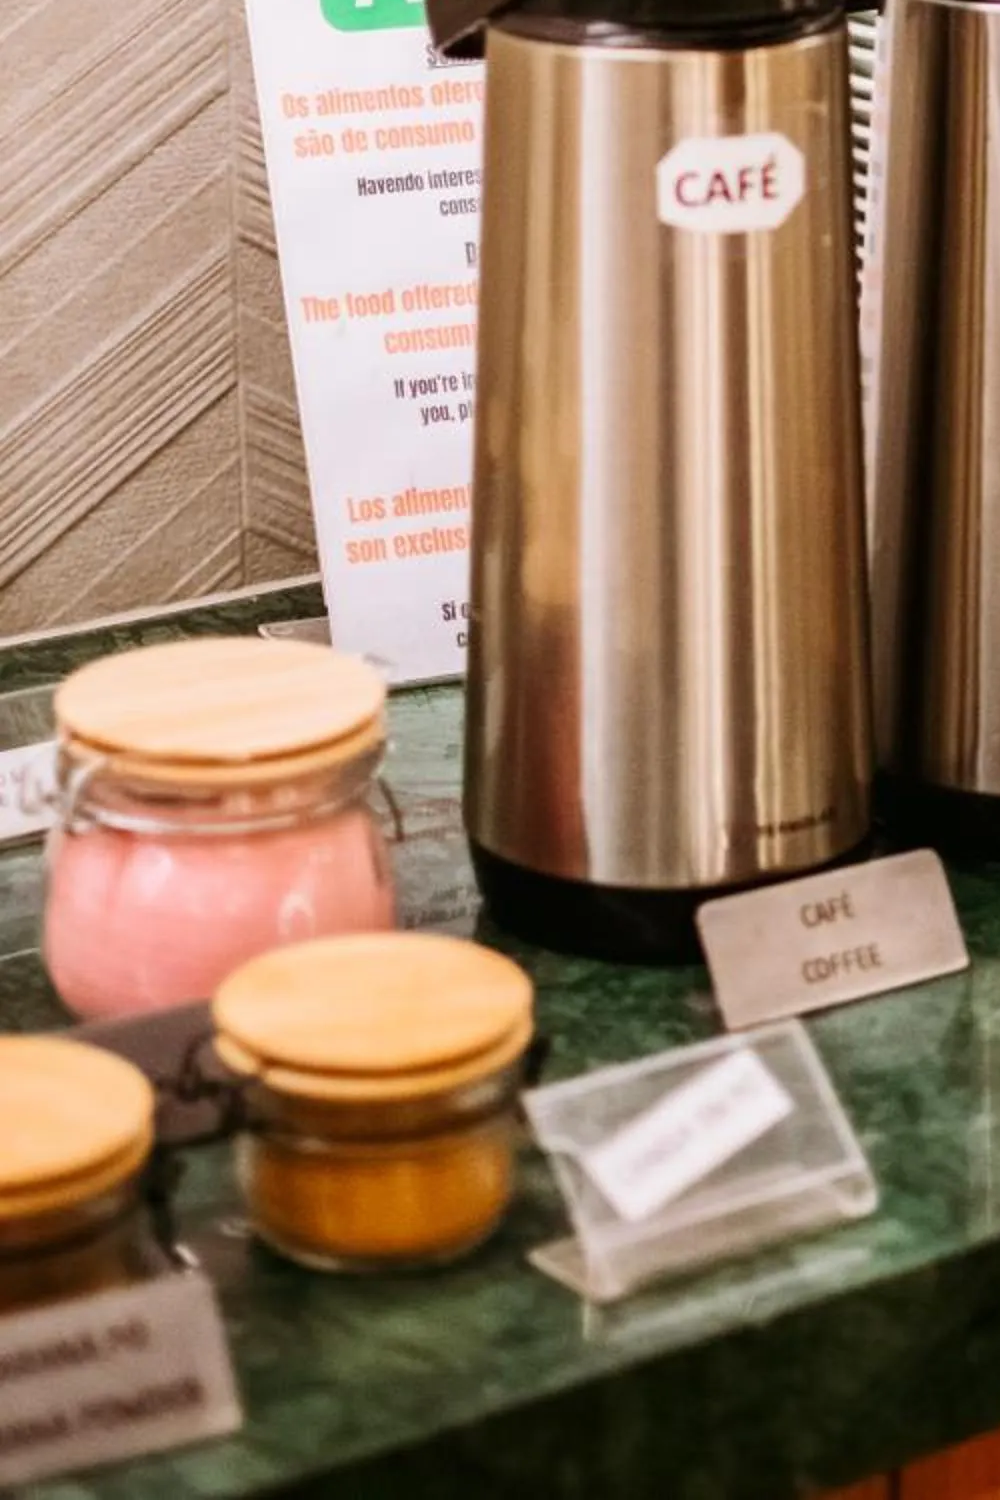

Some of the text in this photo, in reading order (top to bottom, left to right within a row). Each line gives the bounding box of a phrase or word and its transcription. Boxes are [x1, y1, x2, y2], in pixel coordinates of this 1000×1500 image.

[281, 92, 309, 119] Os
[316, 83, 425, 117] alimentos
[294, 120, 475, 158] são de consumo
[357, 172, 424, 197] Havendo
[675, 151, 780, 207] CAFÉ
[439, 197, 480, 217] cons
[301, 296, 340, 322] The
[346, 288, 395, 318] food
[384, 322, 477, 355] consum
[408, 373, 458, 399] you're
[420, 403, 456, 426] you,
[346, 496, 386, 523] Los
[345, 525, 469, 565] son exclus
[441, 600, 457, 621] Si
[800, 889, 857, 929] CAFÉ
[801, 942, 884, 985] COFFEE
